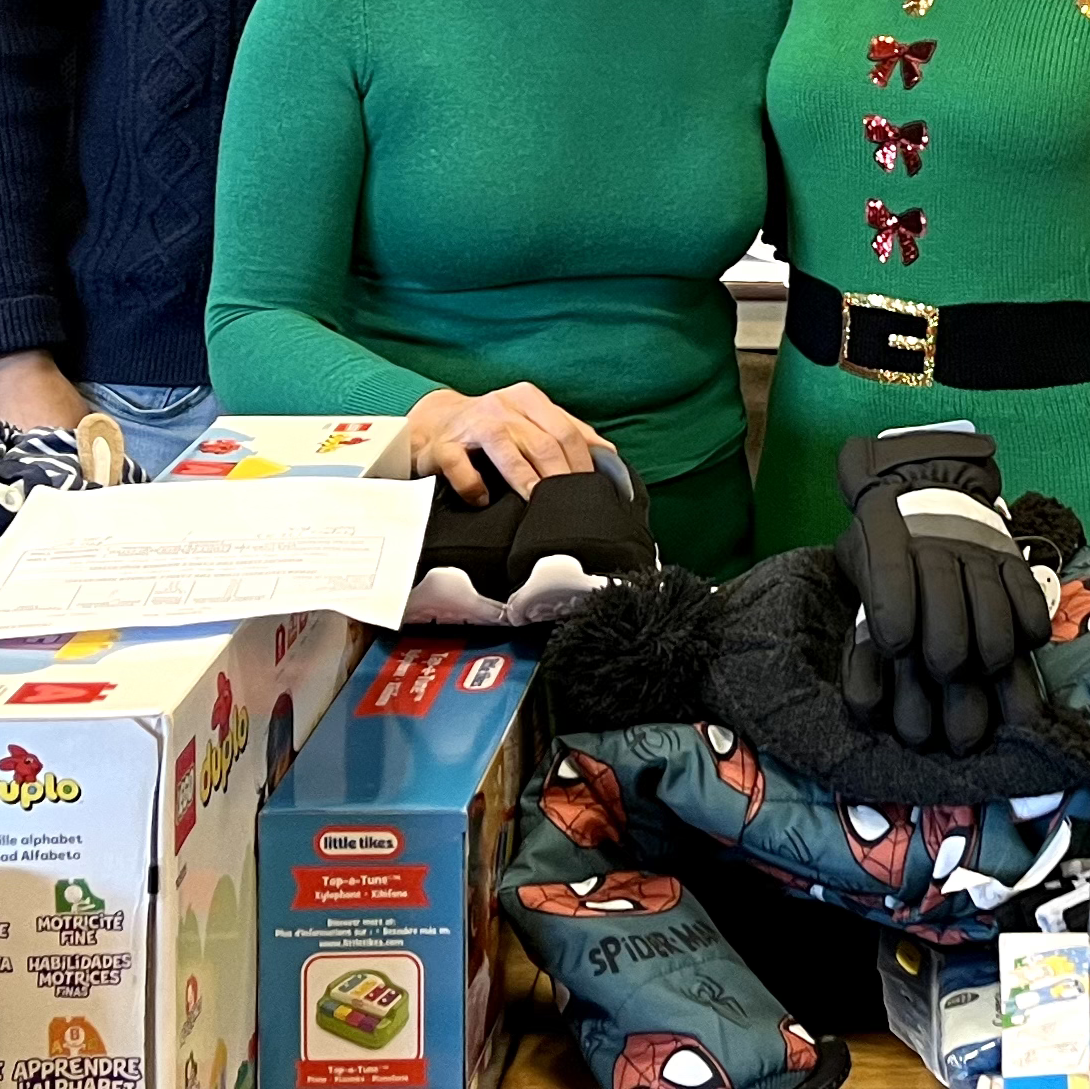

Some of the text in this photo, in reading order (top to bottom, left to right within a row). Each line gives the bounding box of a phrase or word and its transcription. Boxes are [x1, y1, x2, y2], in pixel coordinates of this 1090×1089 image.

[0, 772, 82, 811] uplo
[0, 832, 83, 847] ille alphabet
[324, 836, 395, 851] little tikes
[21, 850, 82, 862] Alfabeto
[36, 911, 126, 932] MOTRICITÉ
[59, 930, 98, 946] FINE
[27, 953, 132, 972] HABILIDADES
[37, 970, 122, 988] MOTRICES
[12, 1057, 143, 1082] APPRENDRE
